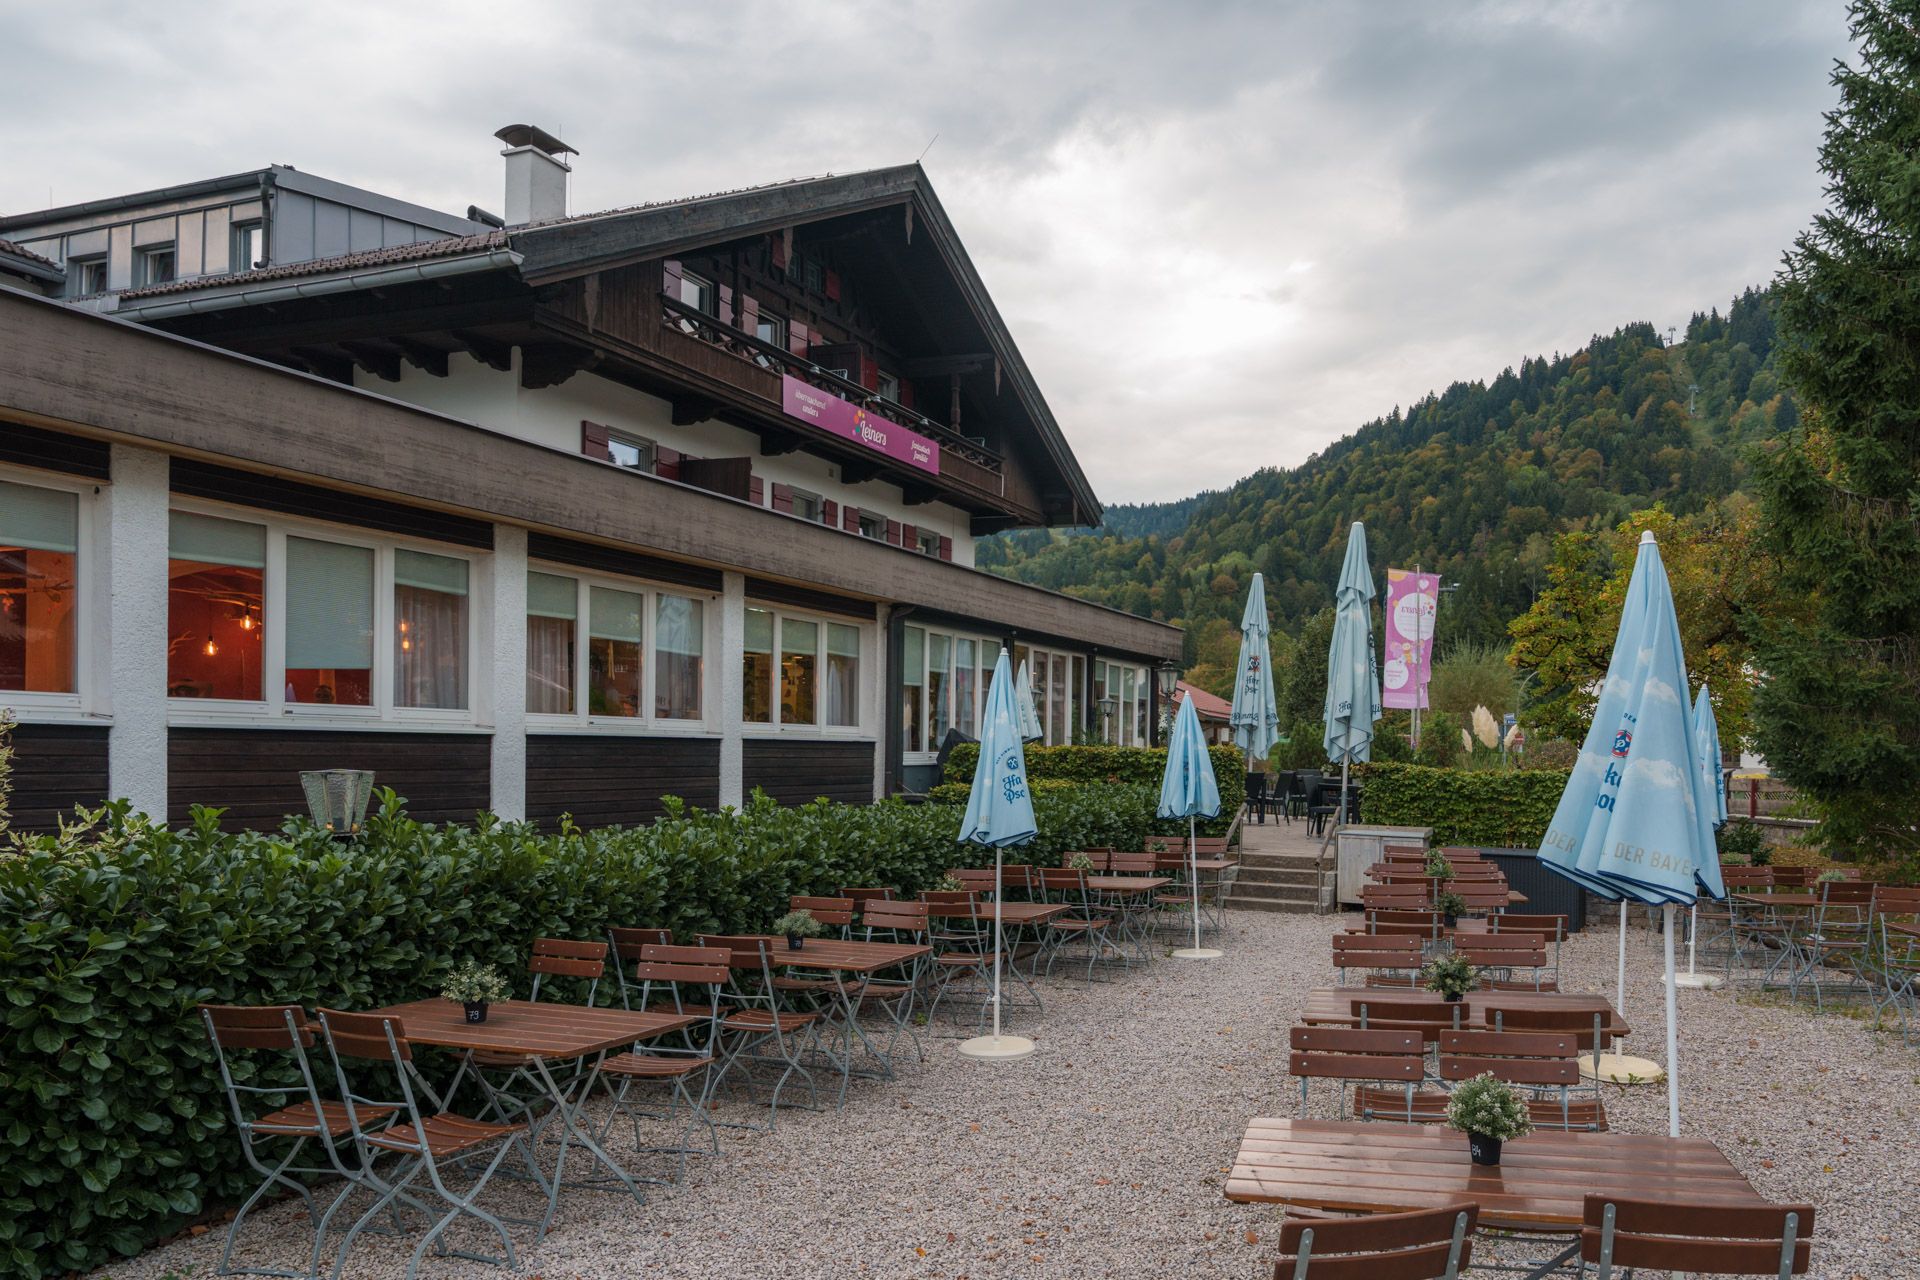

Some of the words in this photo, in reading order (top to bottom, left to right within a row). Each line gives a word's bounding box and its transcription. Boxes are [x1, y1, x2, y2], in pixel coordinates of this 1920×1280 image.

[860, 421, 887, 446] Leiners
[1545, 829, 1577, 854] DER
[1614, 841, 1645, 864] DER
[467, 1010, 479, 1020] 79
